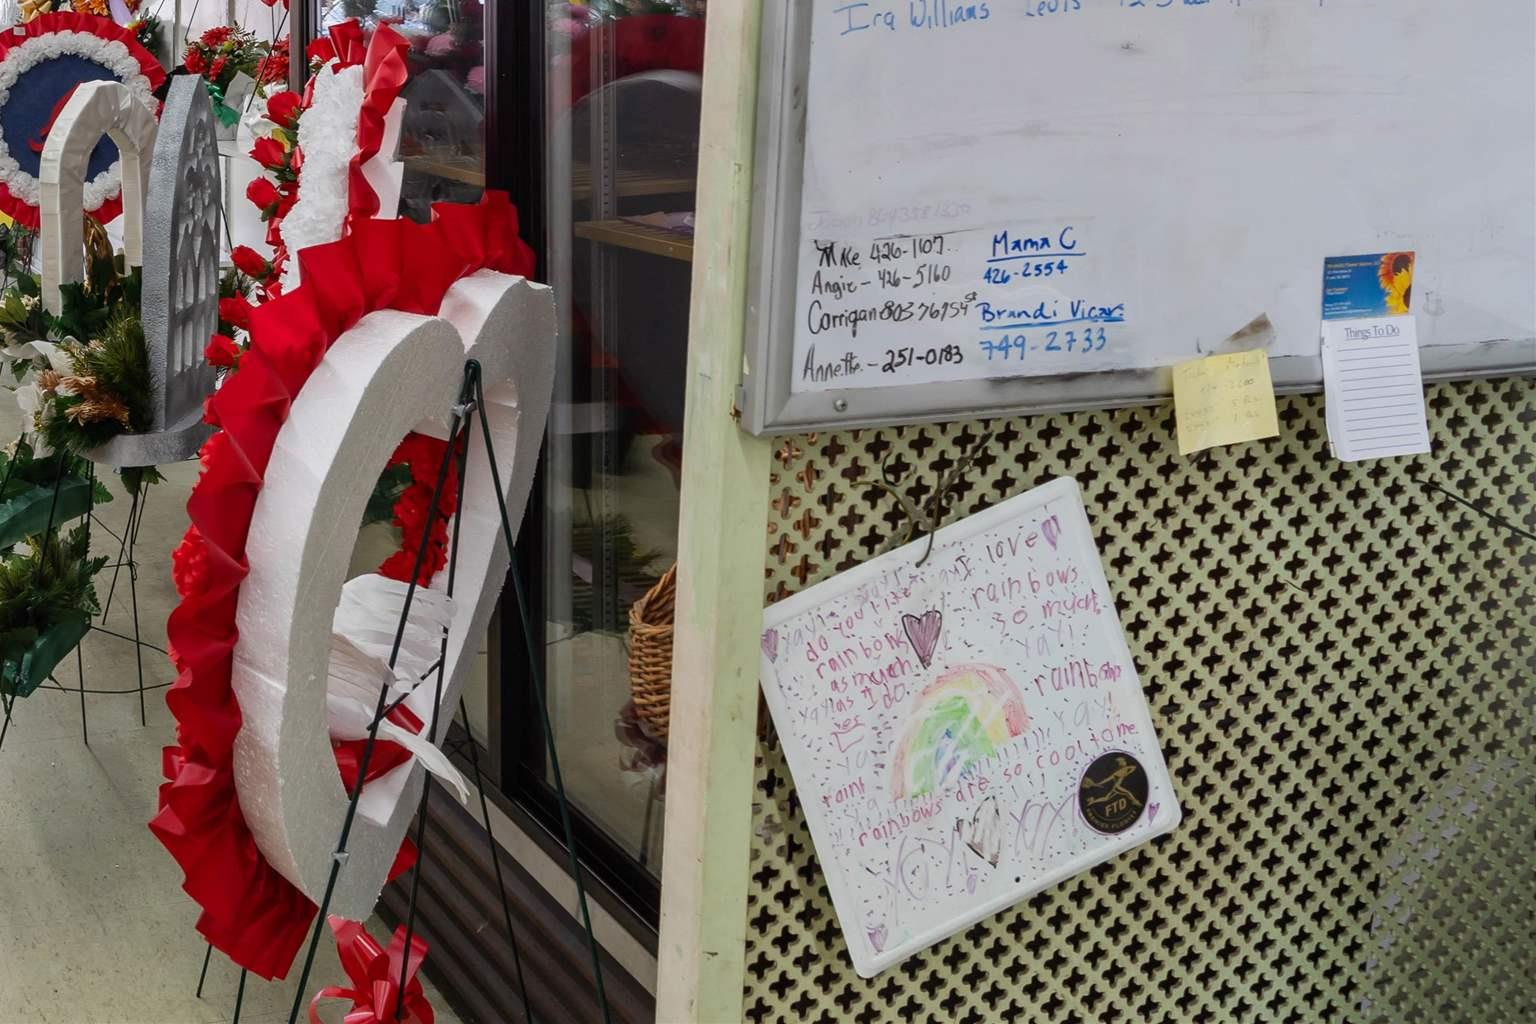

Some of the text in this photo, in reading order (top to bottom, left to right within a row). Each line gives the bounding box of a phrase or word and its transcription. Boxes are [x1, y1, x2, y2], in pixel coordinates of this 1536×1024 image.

[833, 2, 896, 36] Ira
[991, 226, 1077, 258] Mama C
[975, 299, 1058, 323] Brandi
[1344, 323, 1400, 341] Things To Do
[881, 344, 964, 374] 251-0183
[985, 532, 1039, 564] love
[971, 565, 1079, 610] rainbows
[858, 798, 943, 848] rainbows
[1104, 797, 1128, 818] FTD
